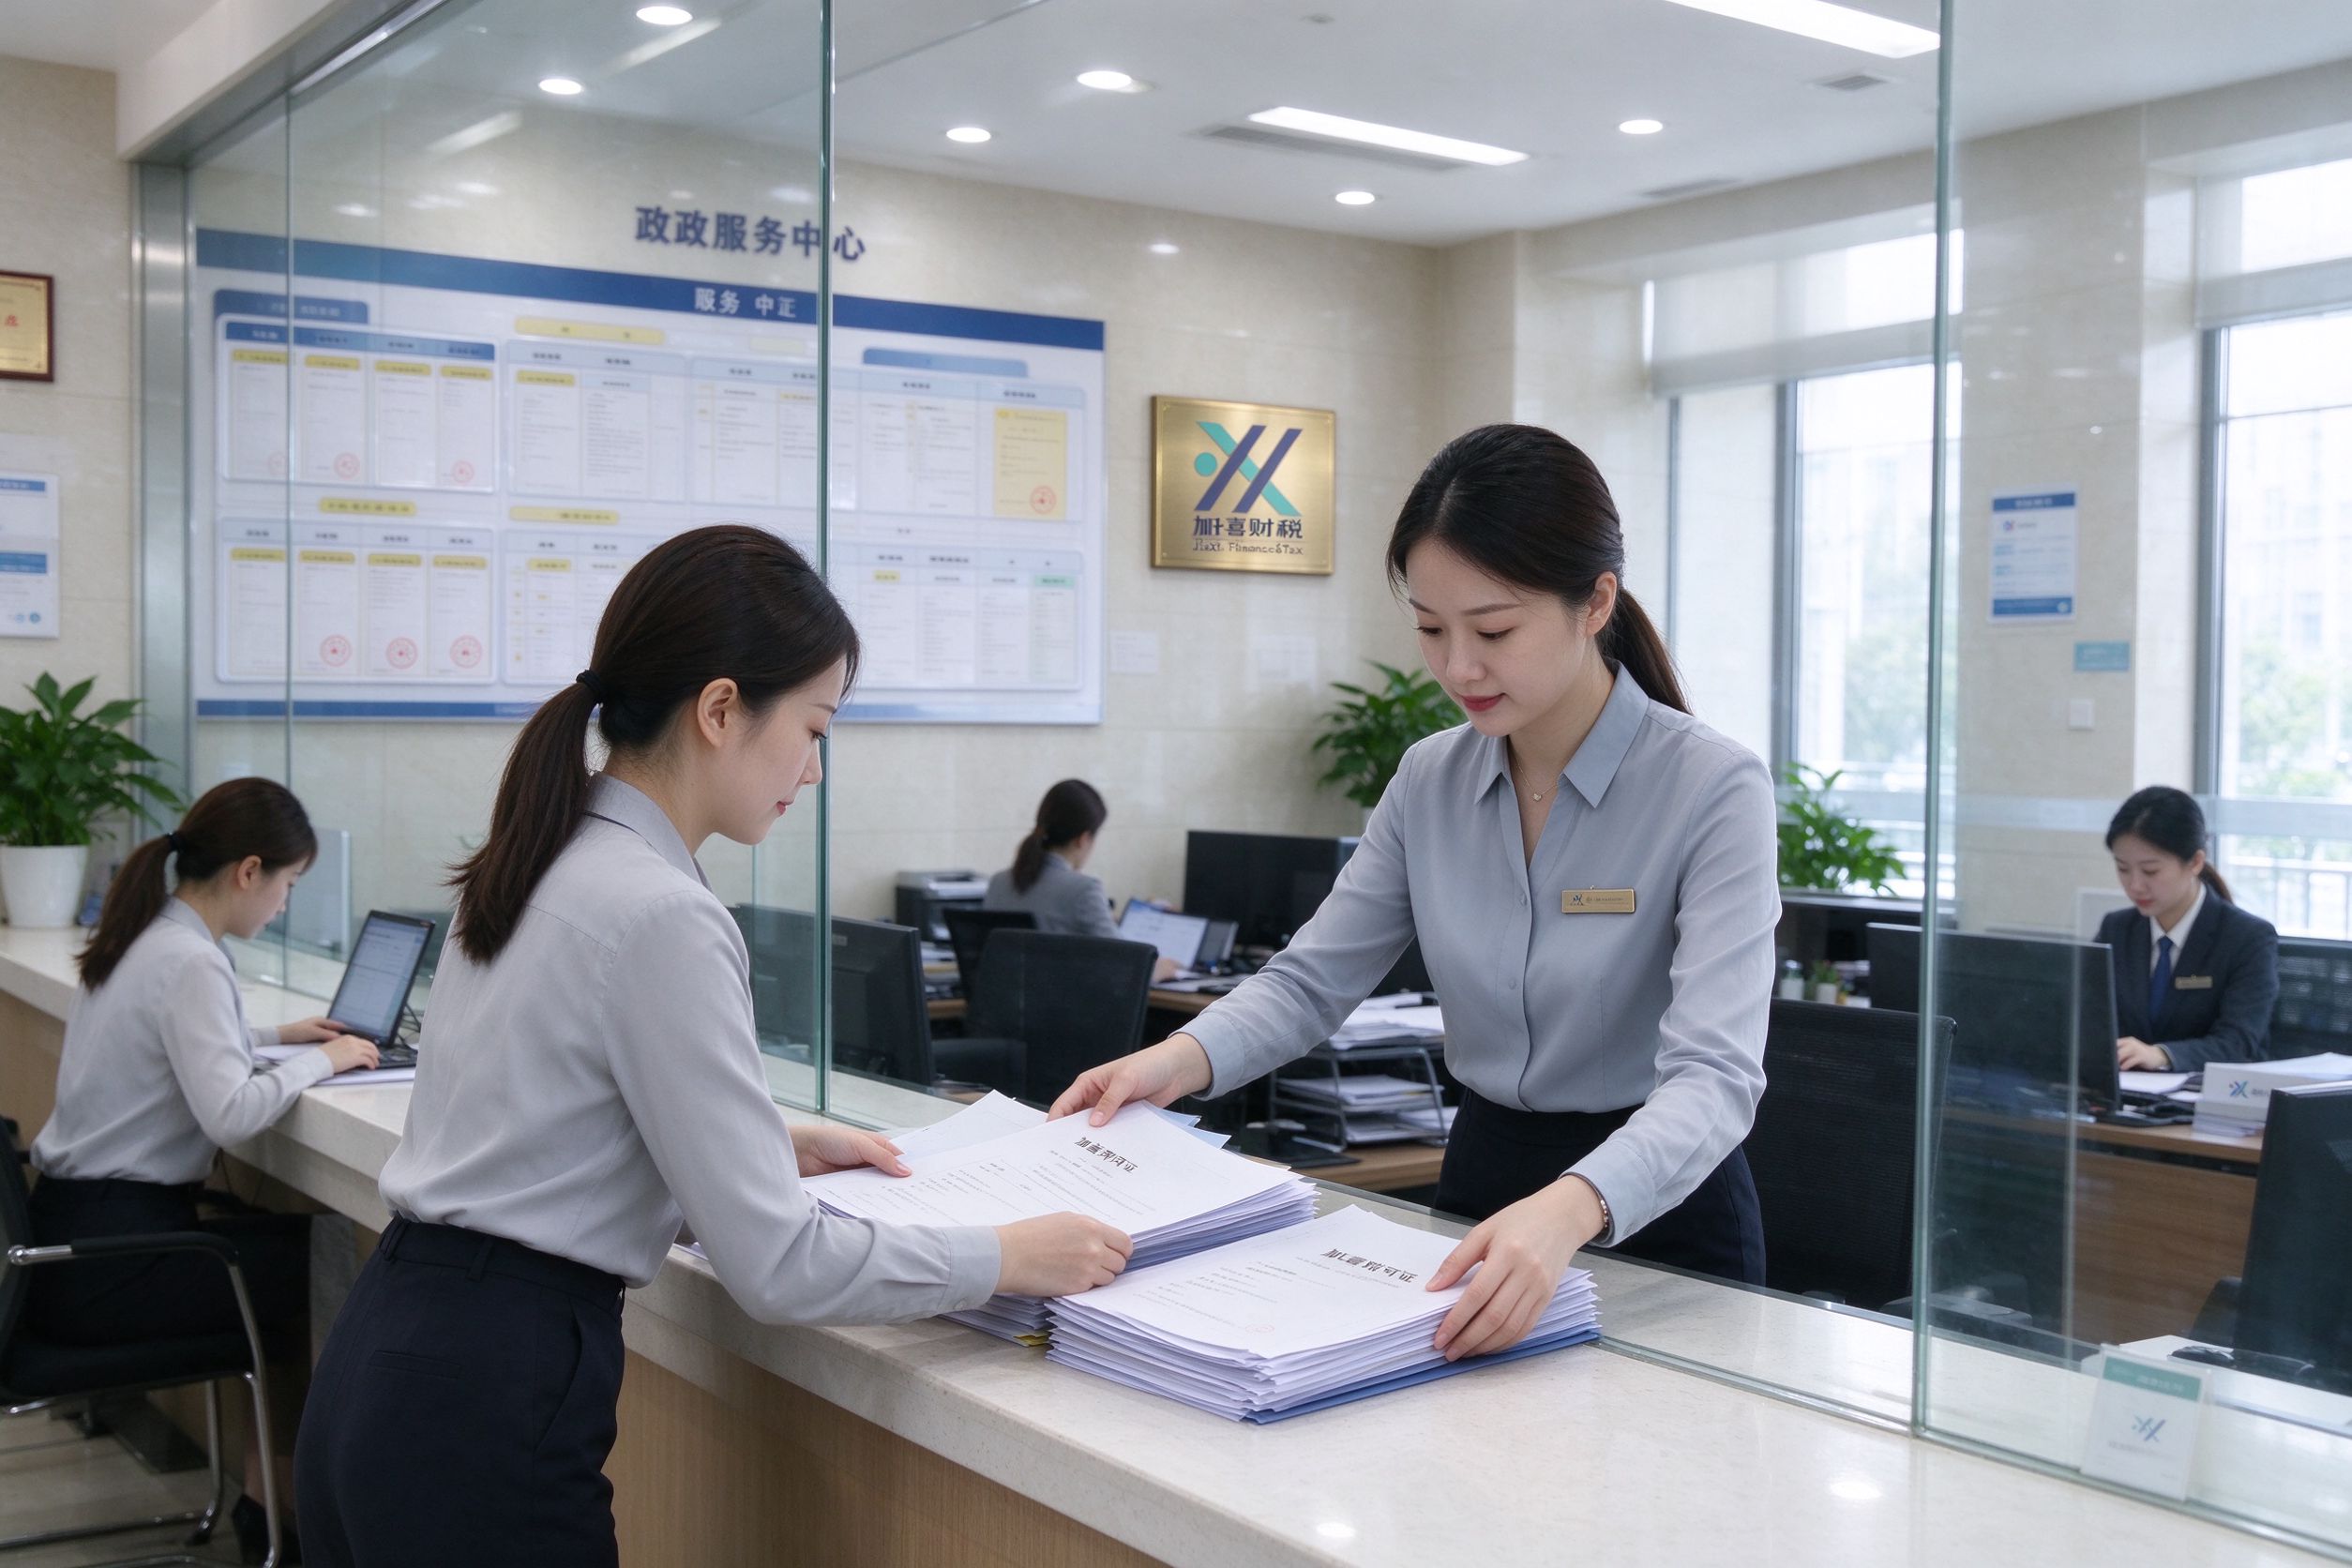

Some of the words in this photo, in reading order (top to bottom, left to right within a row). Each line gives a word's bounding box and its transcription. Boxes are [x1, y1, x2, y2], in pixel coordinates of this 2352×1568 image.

[635, 205, 867, 262] 政政服务中心
